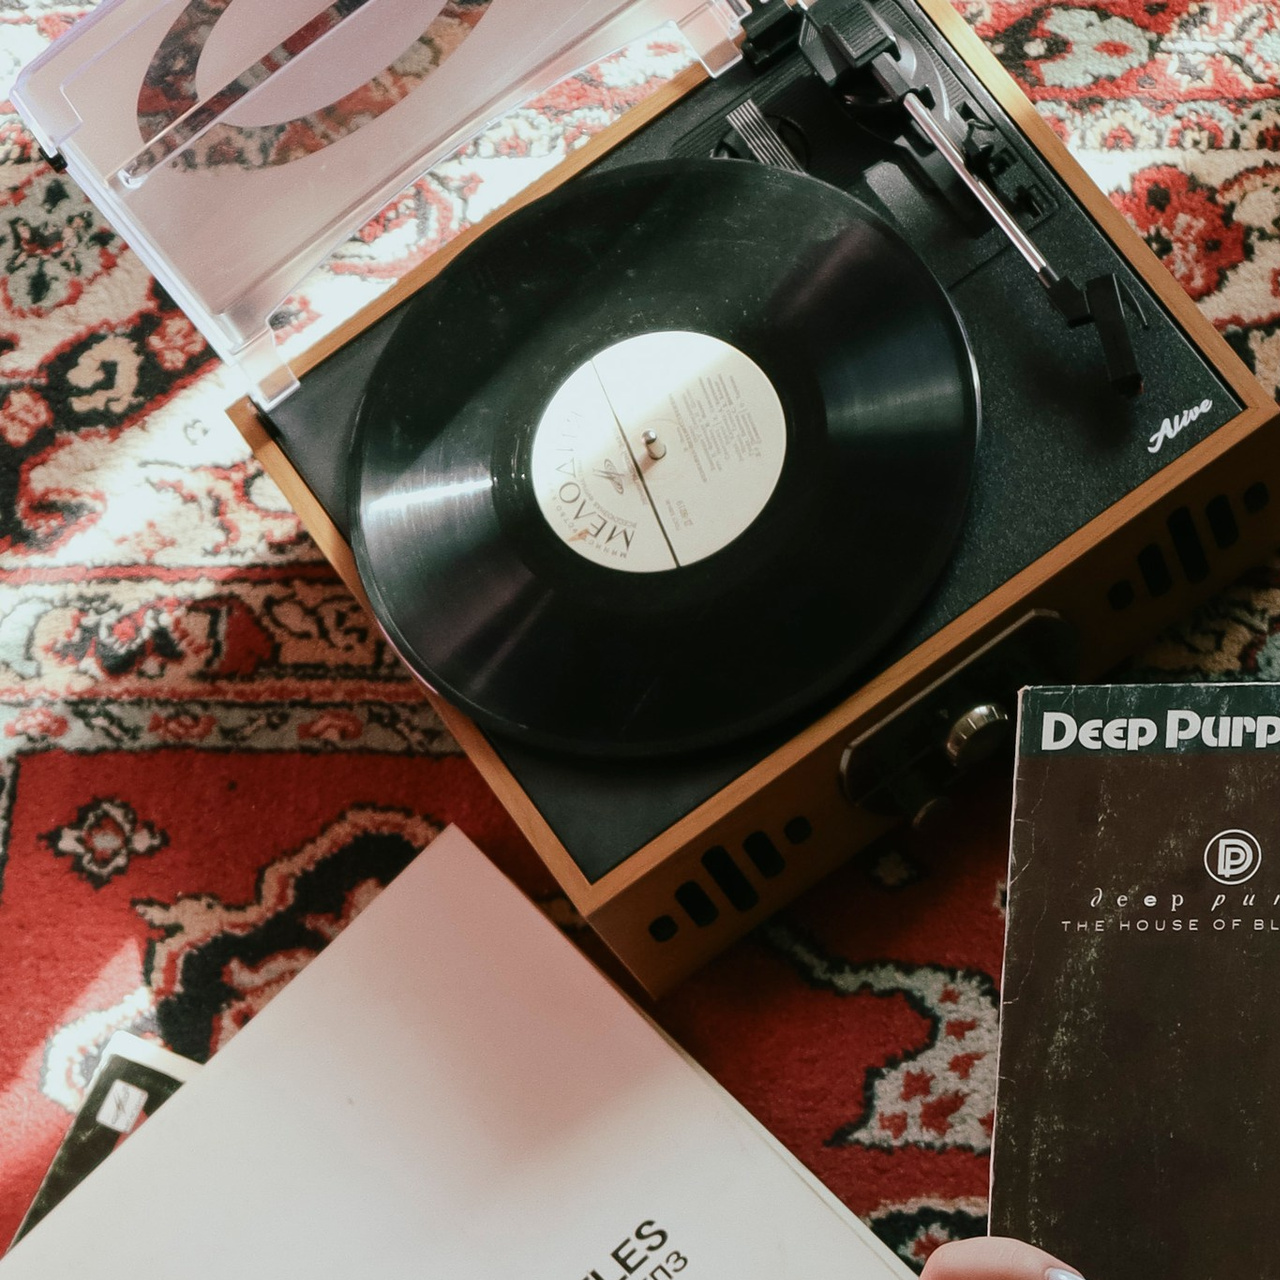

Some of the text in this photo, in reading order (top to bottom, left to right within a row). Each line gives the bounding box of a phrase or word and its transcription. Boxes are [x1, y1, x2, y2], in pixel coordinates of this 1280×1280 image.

[1147, 398, 1213, 453] Alive
[1061, 920, 1106, 932] THE
[1119, 919, 1199, 931] HOUSE
[1213, 918, 1243, 931] OF
